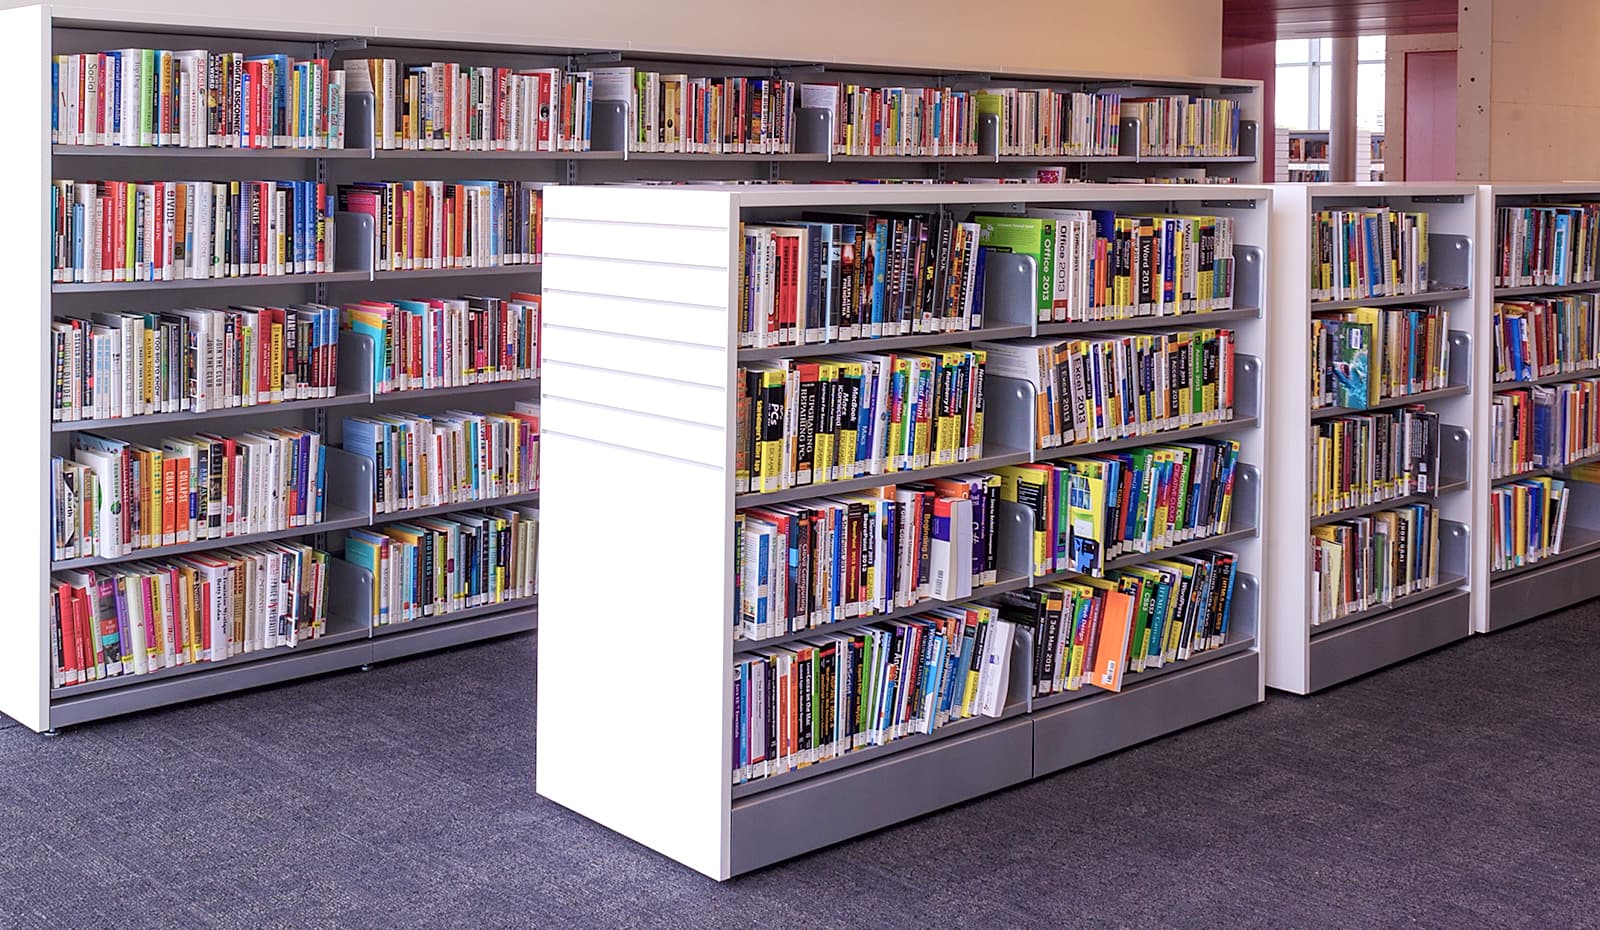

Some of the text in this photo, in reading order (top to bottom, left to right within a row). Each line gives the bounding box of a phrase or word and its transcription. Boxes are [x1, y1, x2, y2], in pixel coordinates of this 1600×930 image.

[87, 63, 97, 93] Social
[233, 91, 241, 136] DISCONNEC
[166, 190, 175, 224] DIVIDE
[1059, 225, 1067, 259] Office
[1142, 244, 1150, 268] Word
[1042, 239, 1052, 301] Office 2013
[155, 365, 161, 375] TO
[215, 338, 223, 387] JOIN THE CLUB
[897, 374, 905, 398] Android
[918, 377, 926, 397] iPad
[943, 371, 952, 404] Raspberry
[976, 368, 984, 408] Networking
[1075, 358, 1086, 423] Excel 2013
[770, 403, 779, 426] PCs
[835, 385, 843, 426] iConnected
[850, 386, 859, 422] MacBook
[917, 399, 925, 419] mini
[798, 388, 807, 461] REPAIRING PCs
[806, 394, 815, 453] UPGRADING
[165, 471, 174, 504] COLLAPSE
[179, 470, 188, 503] COLLAPSE
[1169, 464, 1180, 522] CREATIVE CLOUD
[1177, 465, 1187, 507] Photoshop
[922, 513, 931, 550] Beginning
[1142, 592, 1150, 611] CSS3
[1176, 582, 1188, 618] WordPress
[1219, 579, 1227, 602] HTML5
[1079, 619, 1087, 641] Design
[1151, 586, 1166, 644] HTML5 Canvas
[920, 635, 928, 663] UBUNTU
[927, 628, 935, 659] Windows
[1044, 653, 1053, 673] 2013
